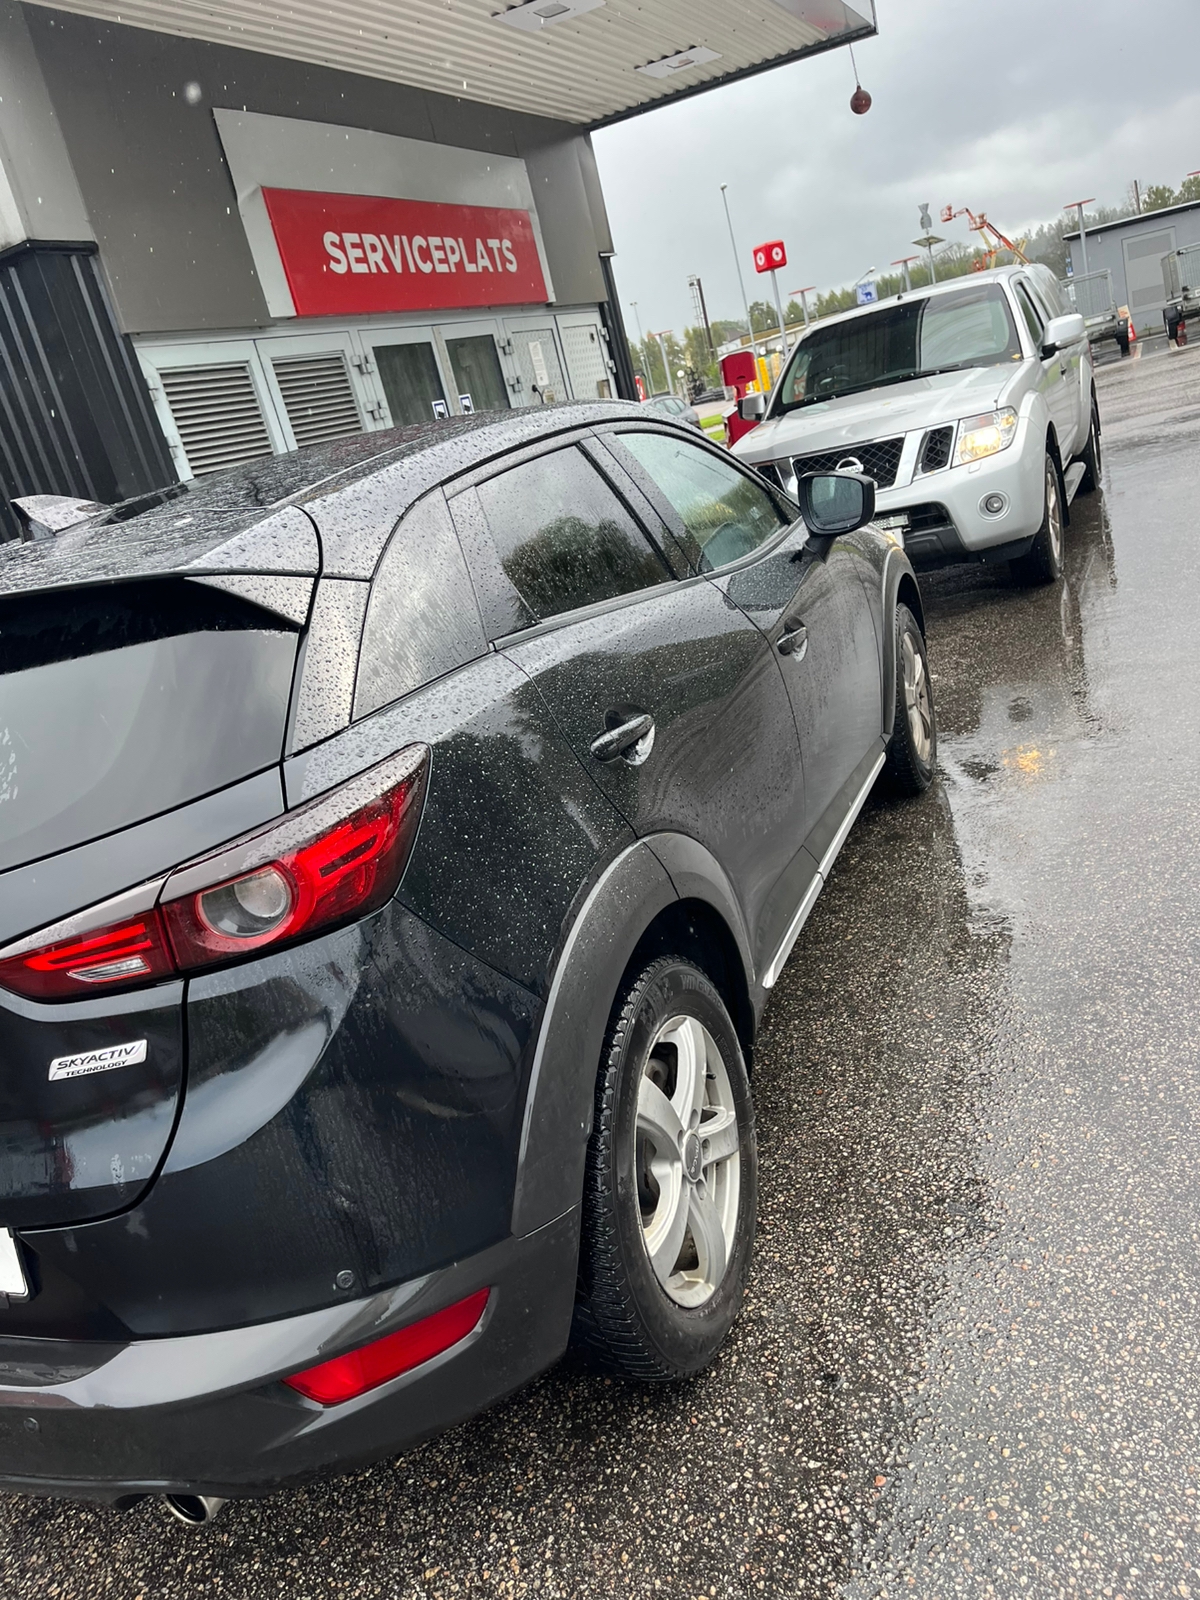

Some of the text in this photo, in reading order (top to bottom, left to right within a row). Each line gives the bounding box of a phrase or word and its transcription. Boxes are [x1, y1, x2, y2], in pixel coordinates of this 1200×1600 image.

[323, 231, 518, 274] SERVICEPLATS
[57, 1046, 136, 1070] SKYACTIV
[65, 1060, 128, 1076] TECHNOLOGY
